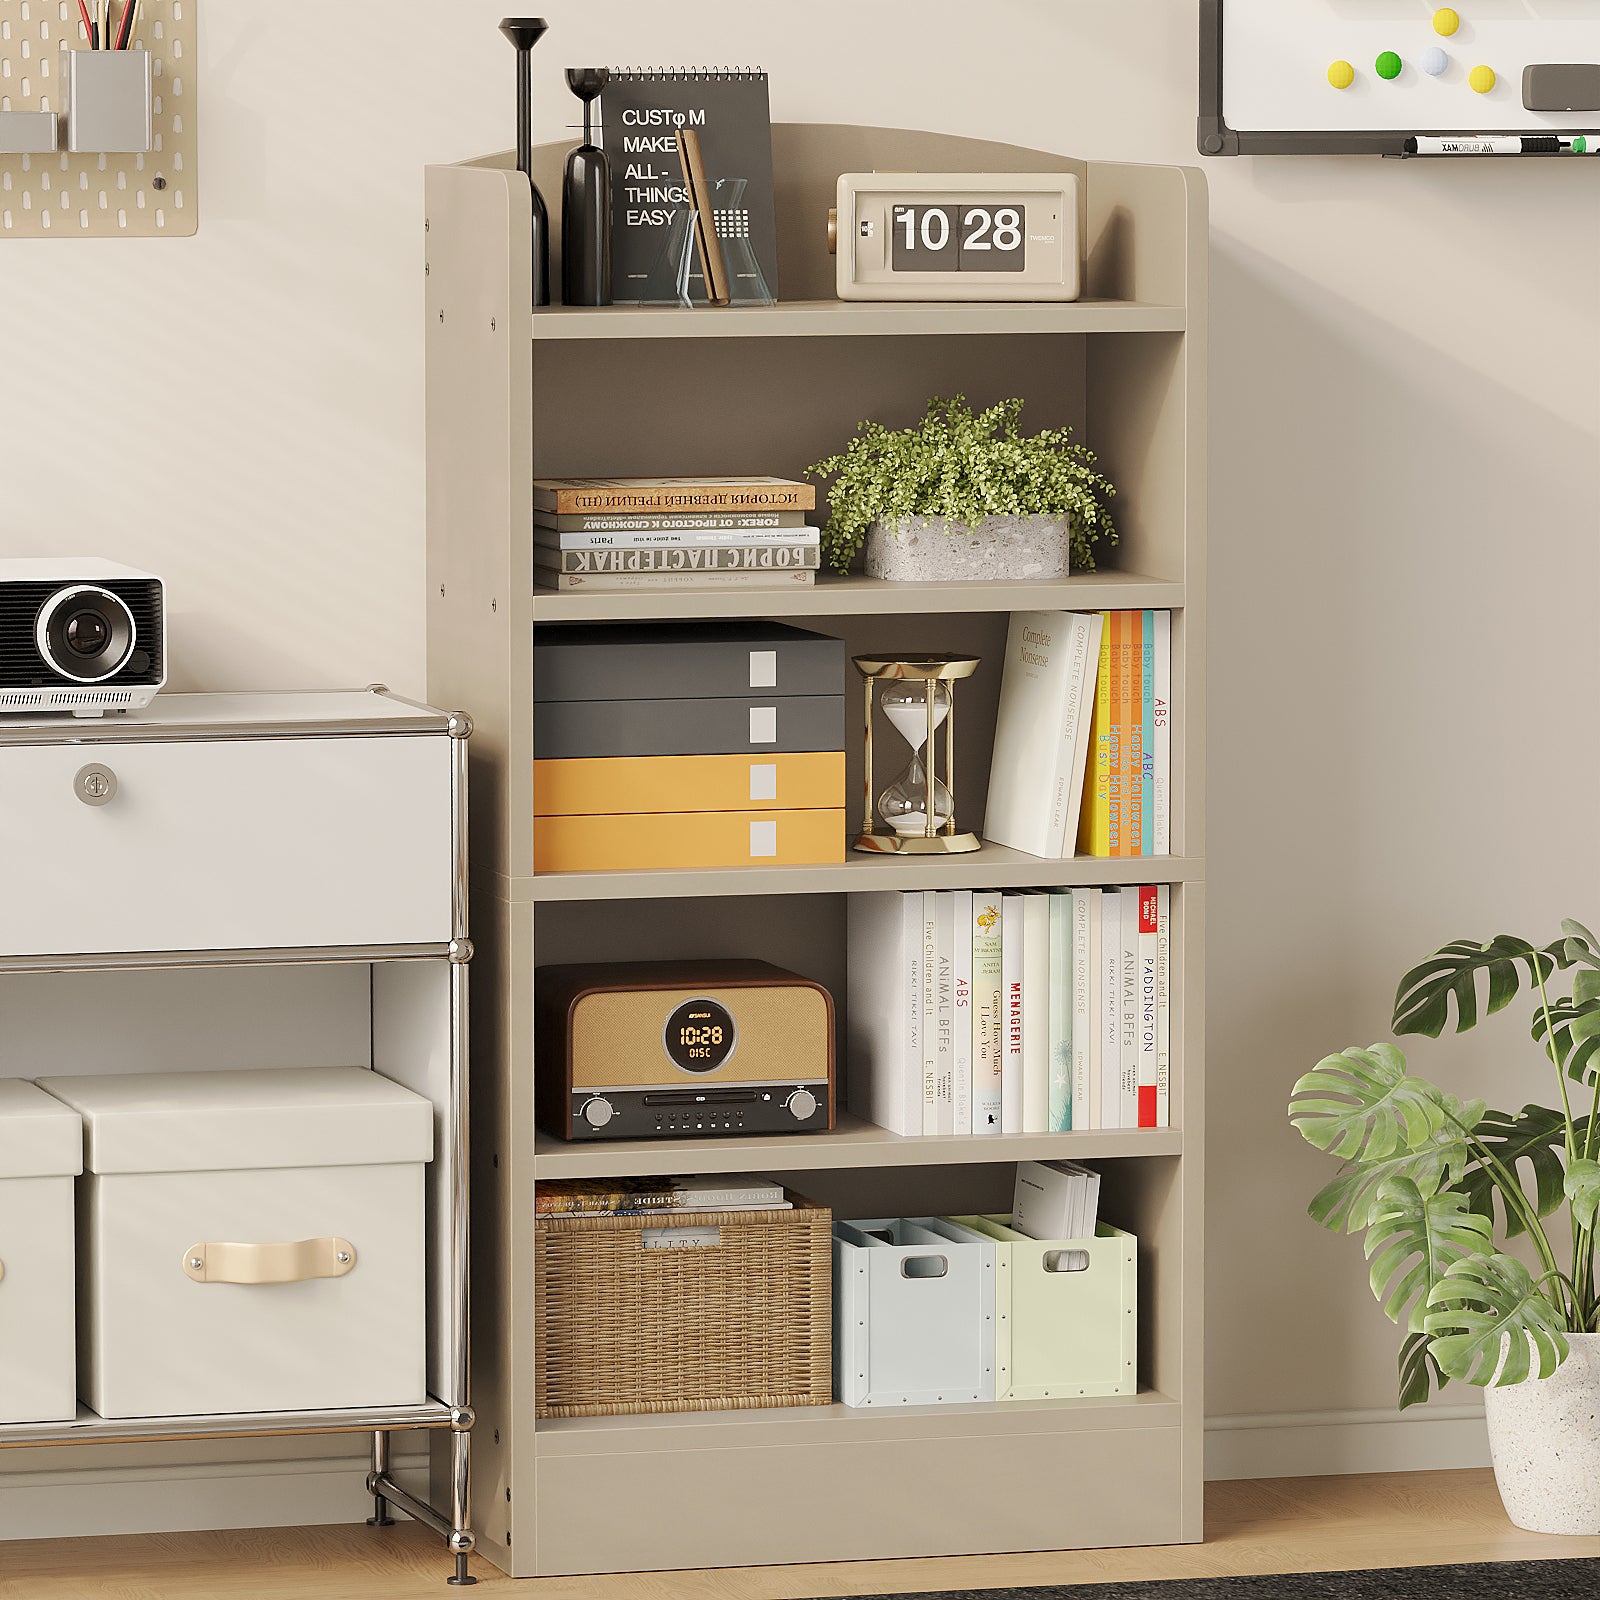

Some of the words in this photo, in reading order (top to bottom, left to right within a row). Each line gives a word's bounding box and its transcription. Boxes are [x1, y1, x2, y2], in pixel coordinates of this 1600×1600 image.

[623, 136, 679, 153] MAKE
[624, 164, 658, 180] ALL
[626, 209, 677, 226] EASY
[896, 208, 950, 250] 10
[963, 208, 1022, 250] 28
[606, 495, 662, 506] ГРЕЦИИ
[666, 494, 728, 507] ДРЕВНЕЙ
[731, 493, 798, 504] ИСТОРИЯ
[574, 548, 720, 572] ПАСТЕРНАК
[726, 547, 806, 568] БОРИС
[1022, 626, 1052, 648] Complete
[1020, 646, 1048, 668] Nonsense
[1072, 626, 1086, 680] COMPLETE
[1100, 644, 1110, 670] Baby
[1111, 644, 1120, 670] Baby
[1122, 644, 1131, 670] Baby
[1132, 644, 1142, 670] Baby
[1143, 643, 1152, 670] Baby
[1112, 674, 1120, 704] touch
[1122, 674, 1130, 704] touch
[1132, 674, 1141, 704] touch
[1144, 674, 1152, 704] touch
[1064, 686, 1078, 741] NONSENSE
[1154, 698, 1166, 728] ABS
[1098, 735, 1109, 766] Busy
[1110, 725, 1120, 768] Happy
[1131, 724, 1142, 767] Happy
[1142, 752, 1153, 780] ABC
[1098, 774, 1109, 799] Day
[1156, 778, 1164, 811] Quentin
[1110, 776, 1120, 847] Halloween
[1131, 774, 1142, 847] Halloween
[1078, 899, 1086, 954] COMPLETE
[956, 978, 968, 1008] ABS
[1078, 959, 1086, 1014] NONSENSE
[992, 990, 1001, 1019] Guess
[1010, 982, 1020, 1054] MENAGERIE
[1143, 958, 1154, 1052] PADDINGTON
[680, 1026, 722, 1046] 10:28
[939, 1019, 950, 1053] BFFs
[980, 1013, 990, 1037] Love
[1124, 1013, 1134, 1046] BFFs
[980, 1039, 990, 1059] You
[992, 1049, 1001, 1076] Much
